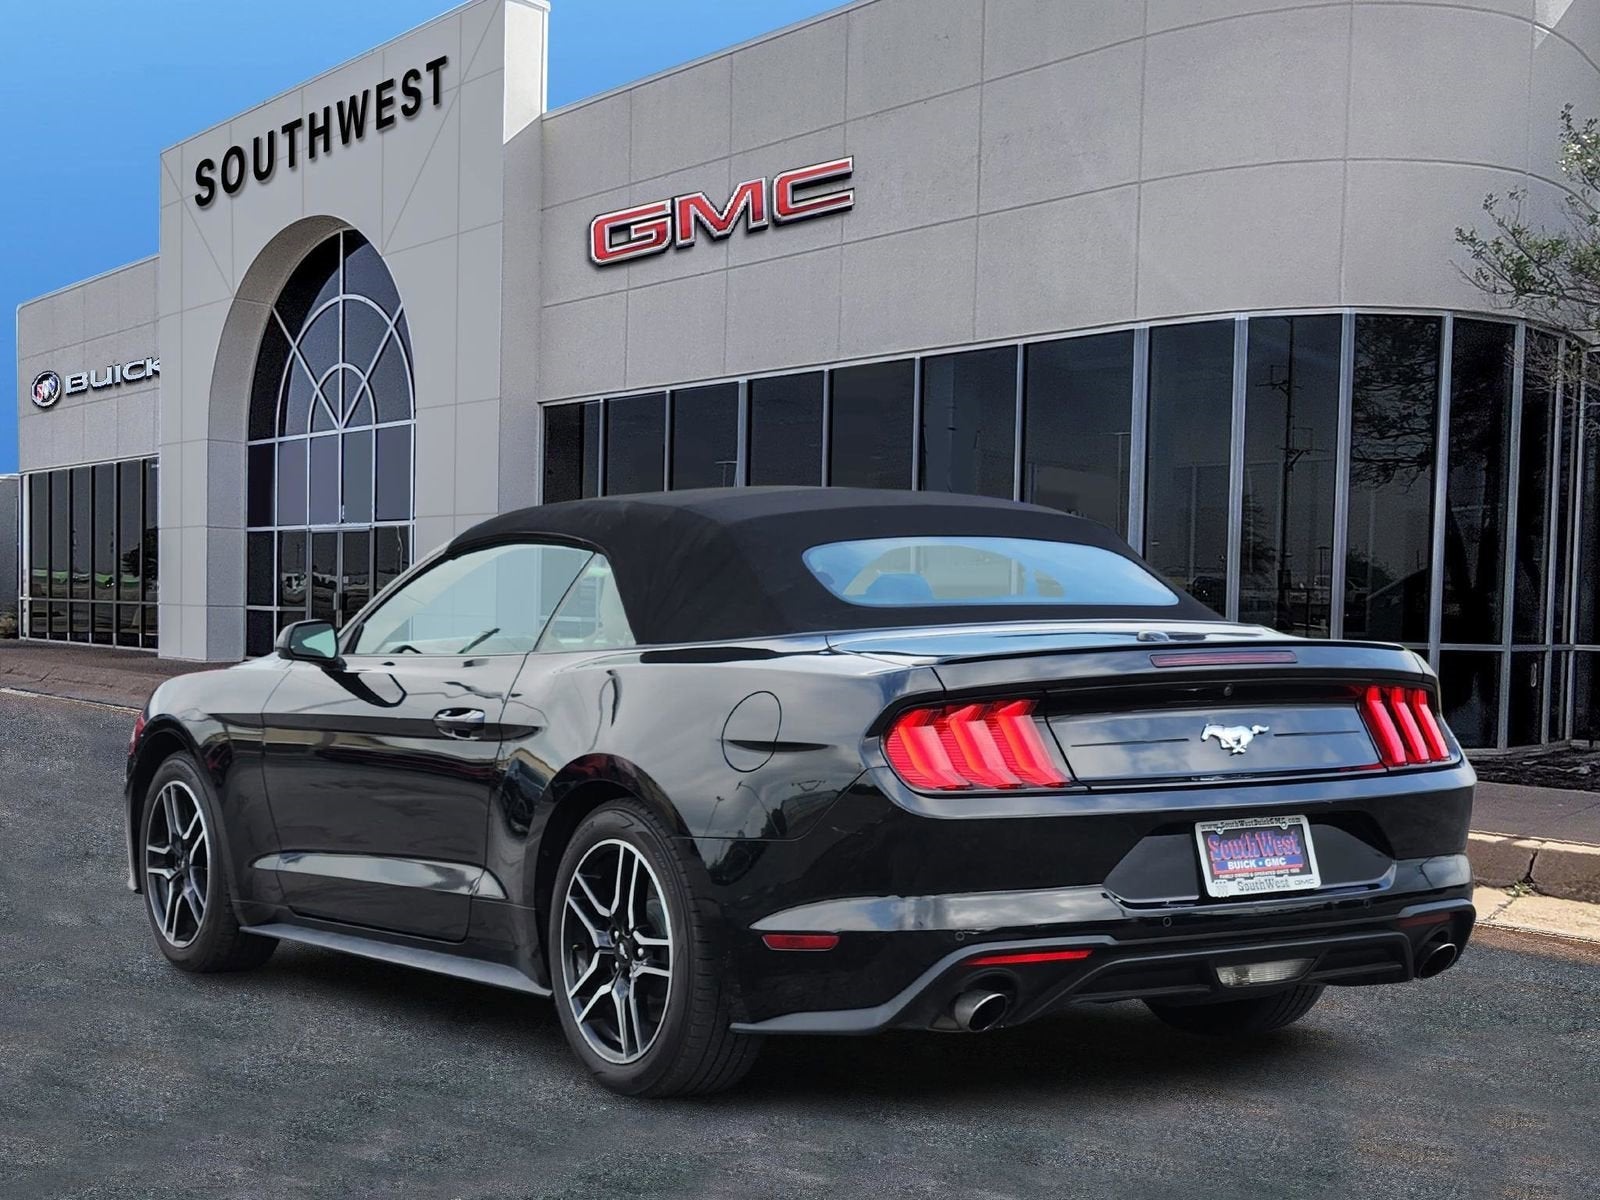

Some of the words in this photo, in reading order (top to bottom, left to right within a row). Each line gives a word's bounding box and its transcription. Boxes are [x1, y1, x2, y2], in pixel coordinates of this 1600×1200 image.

[195, 55, 448, 207] SOUTHWEST
[588, 155, 855, 266] GMC
[64, 357, 160, 395] BUICK
[1227, 858, 1257, 870] BUICK
[1265, 857, 1287, 867] GMC
